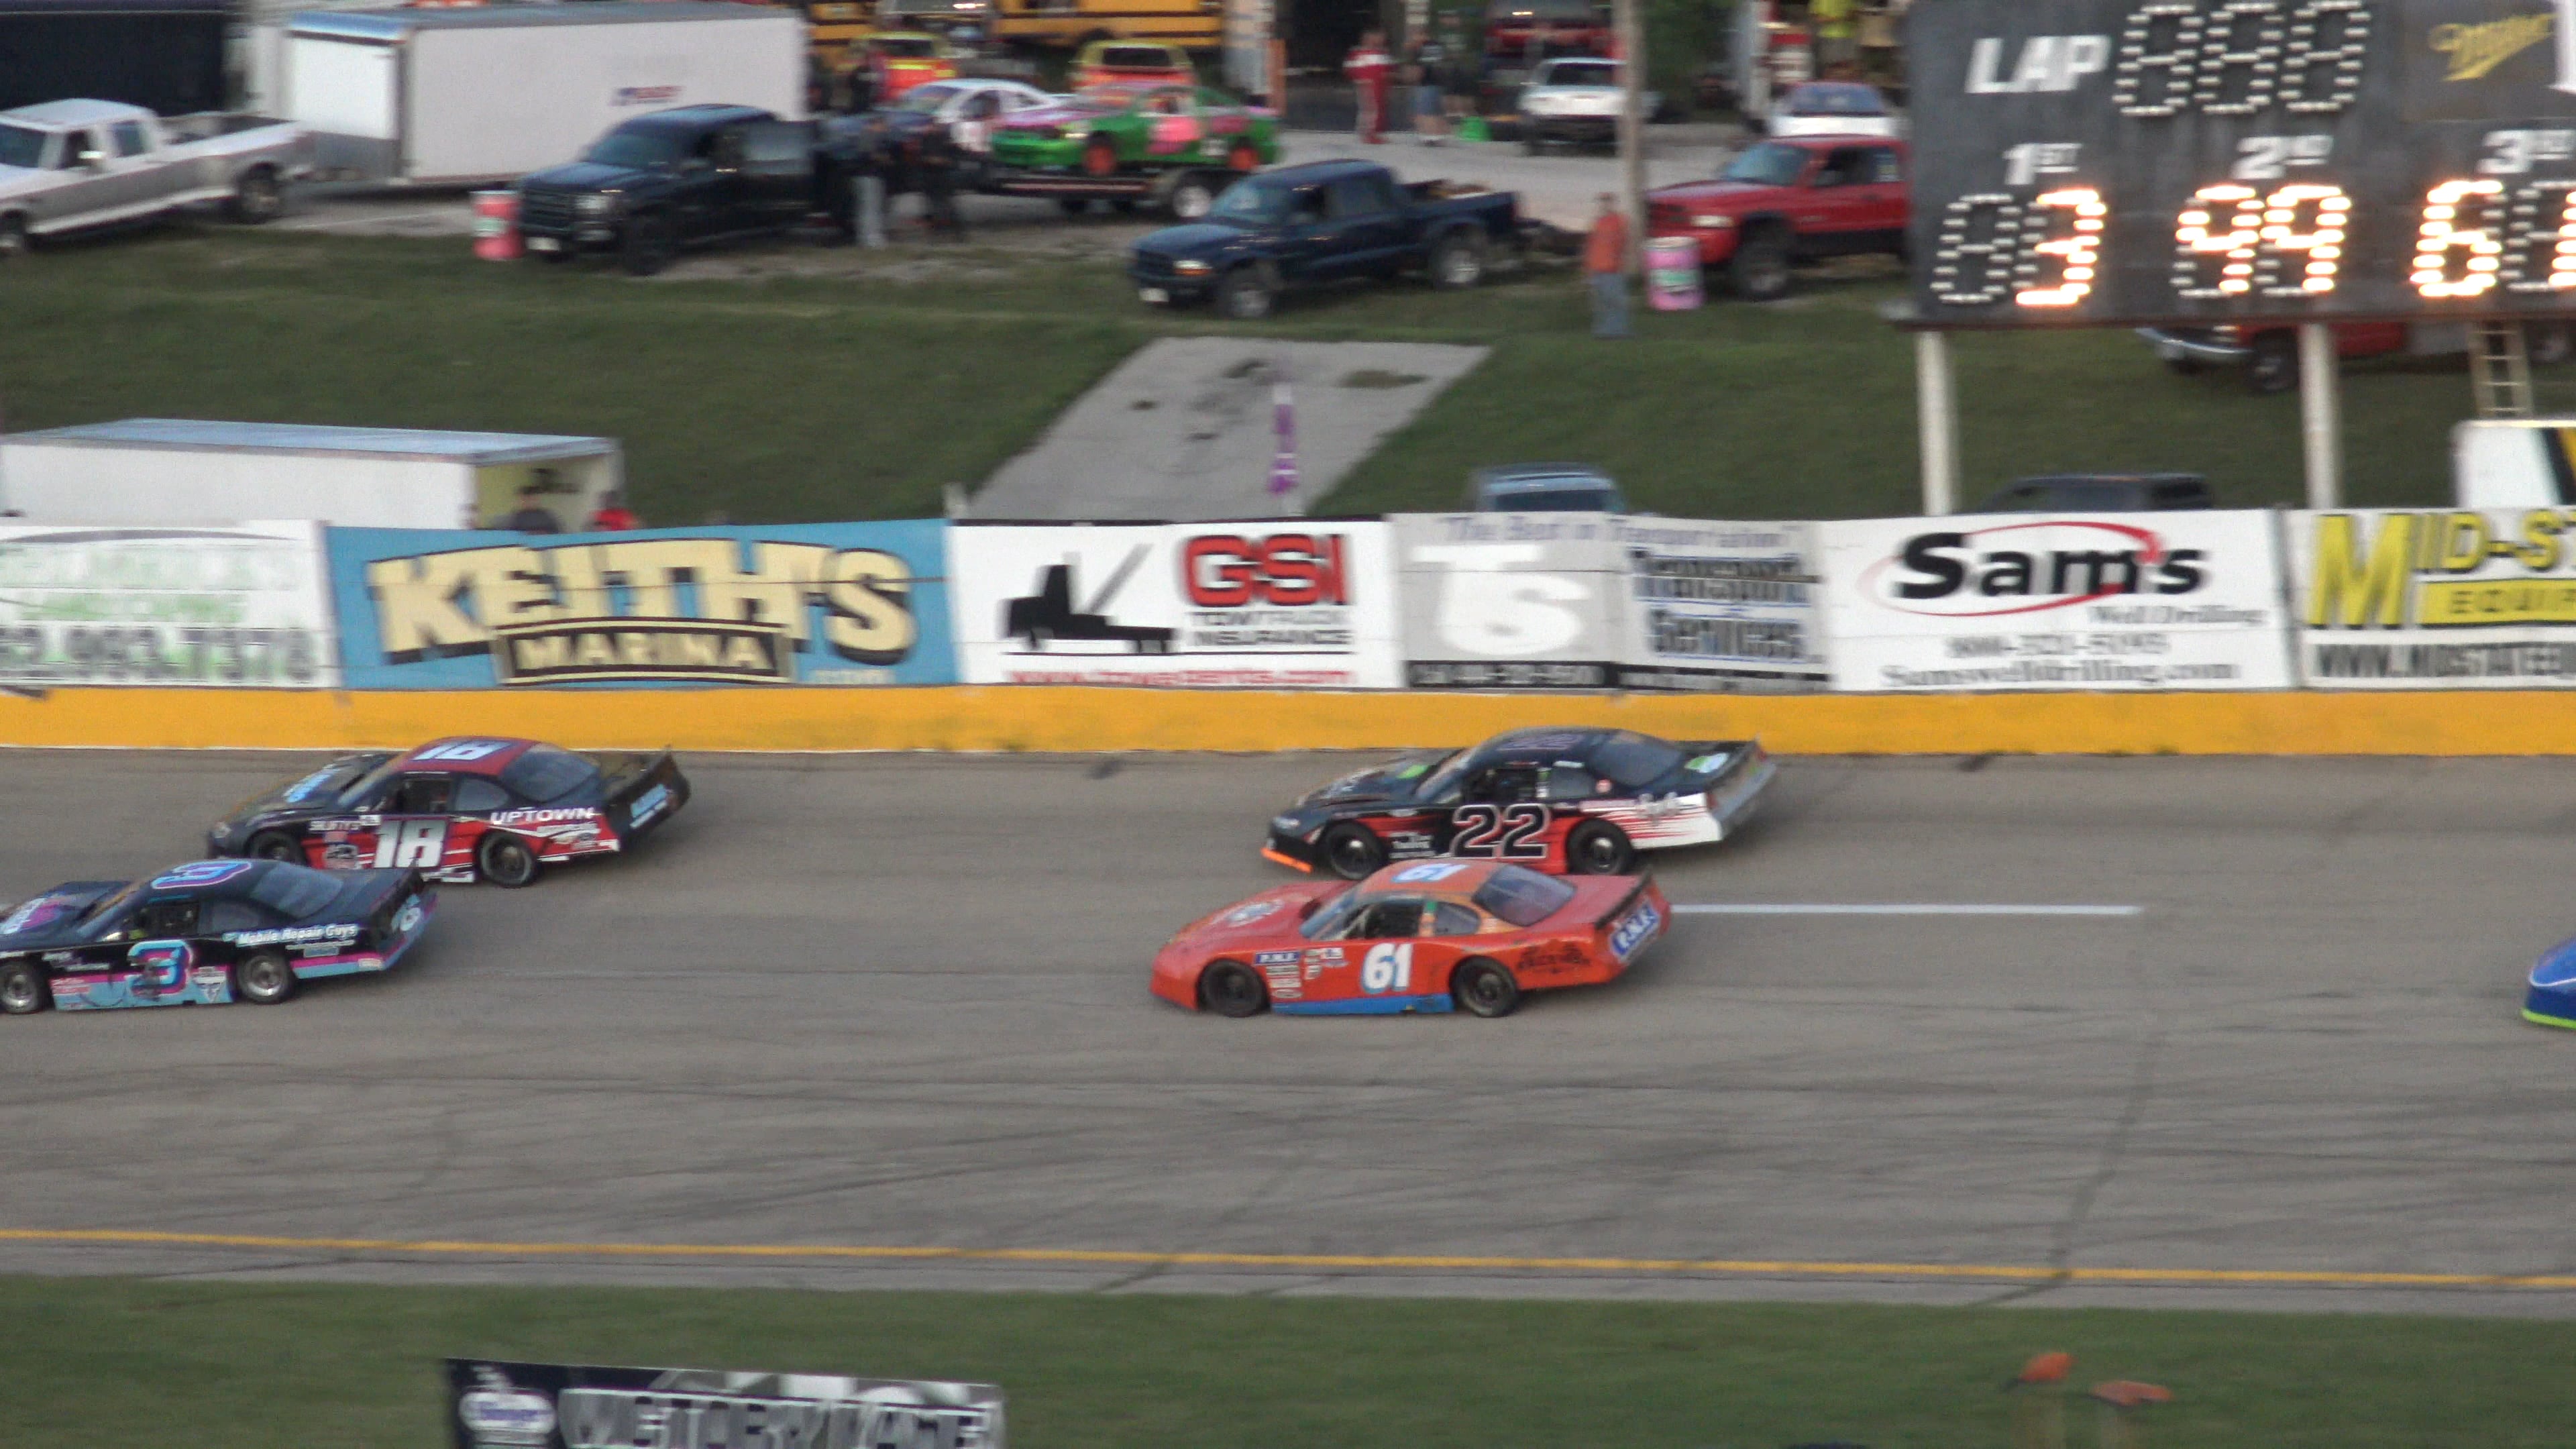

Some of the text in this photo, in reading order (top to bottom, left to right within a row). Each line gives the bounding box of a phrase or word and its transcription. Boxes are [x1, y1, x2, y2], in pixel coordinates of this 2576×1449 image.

[1965, 35, 2110, 94] LAP
[1179, 533, 1356, 608] GSI
[2308, 511, 2576, 629] MID-S
[367, 537, 916, 665] KEITH'S
[511, 633, 777, 670] MARINA
[373, 820, 447, 869] 18
[490, 807, 596, 825] UPTOWN
[1448, 803, 1551, 860] 22
[1362, 942, 1415, 994] 61
